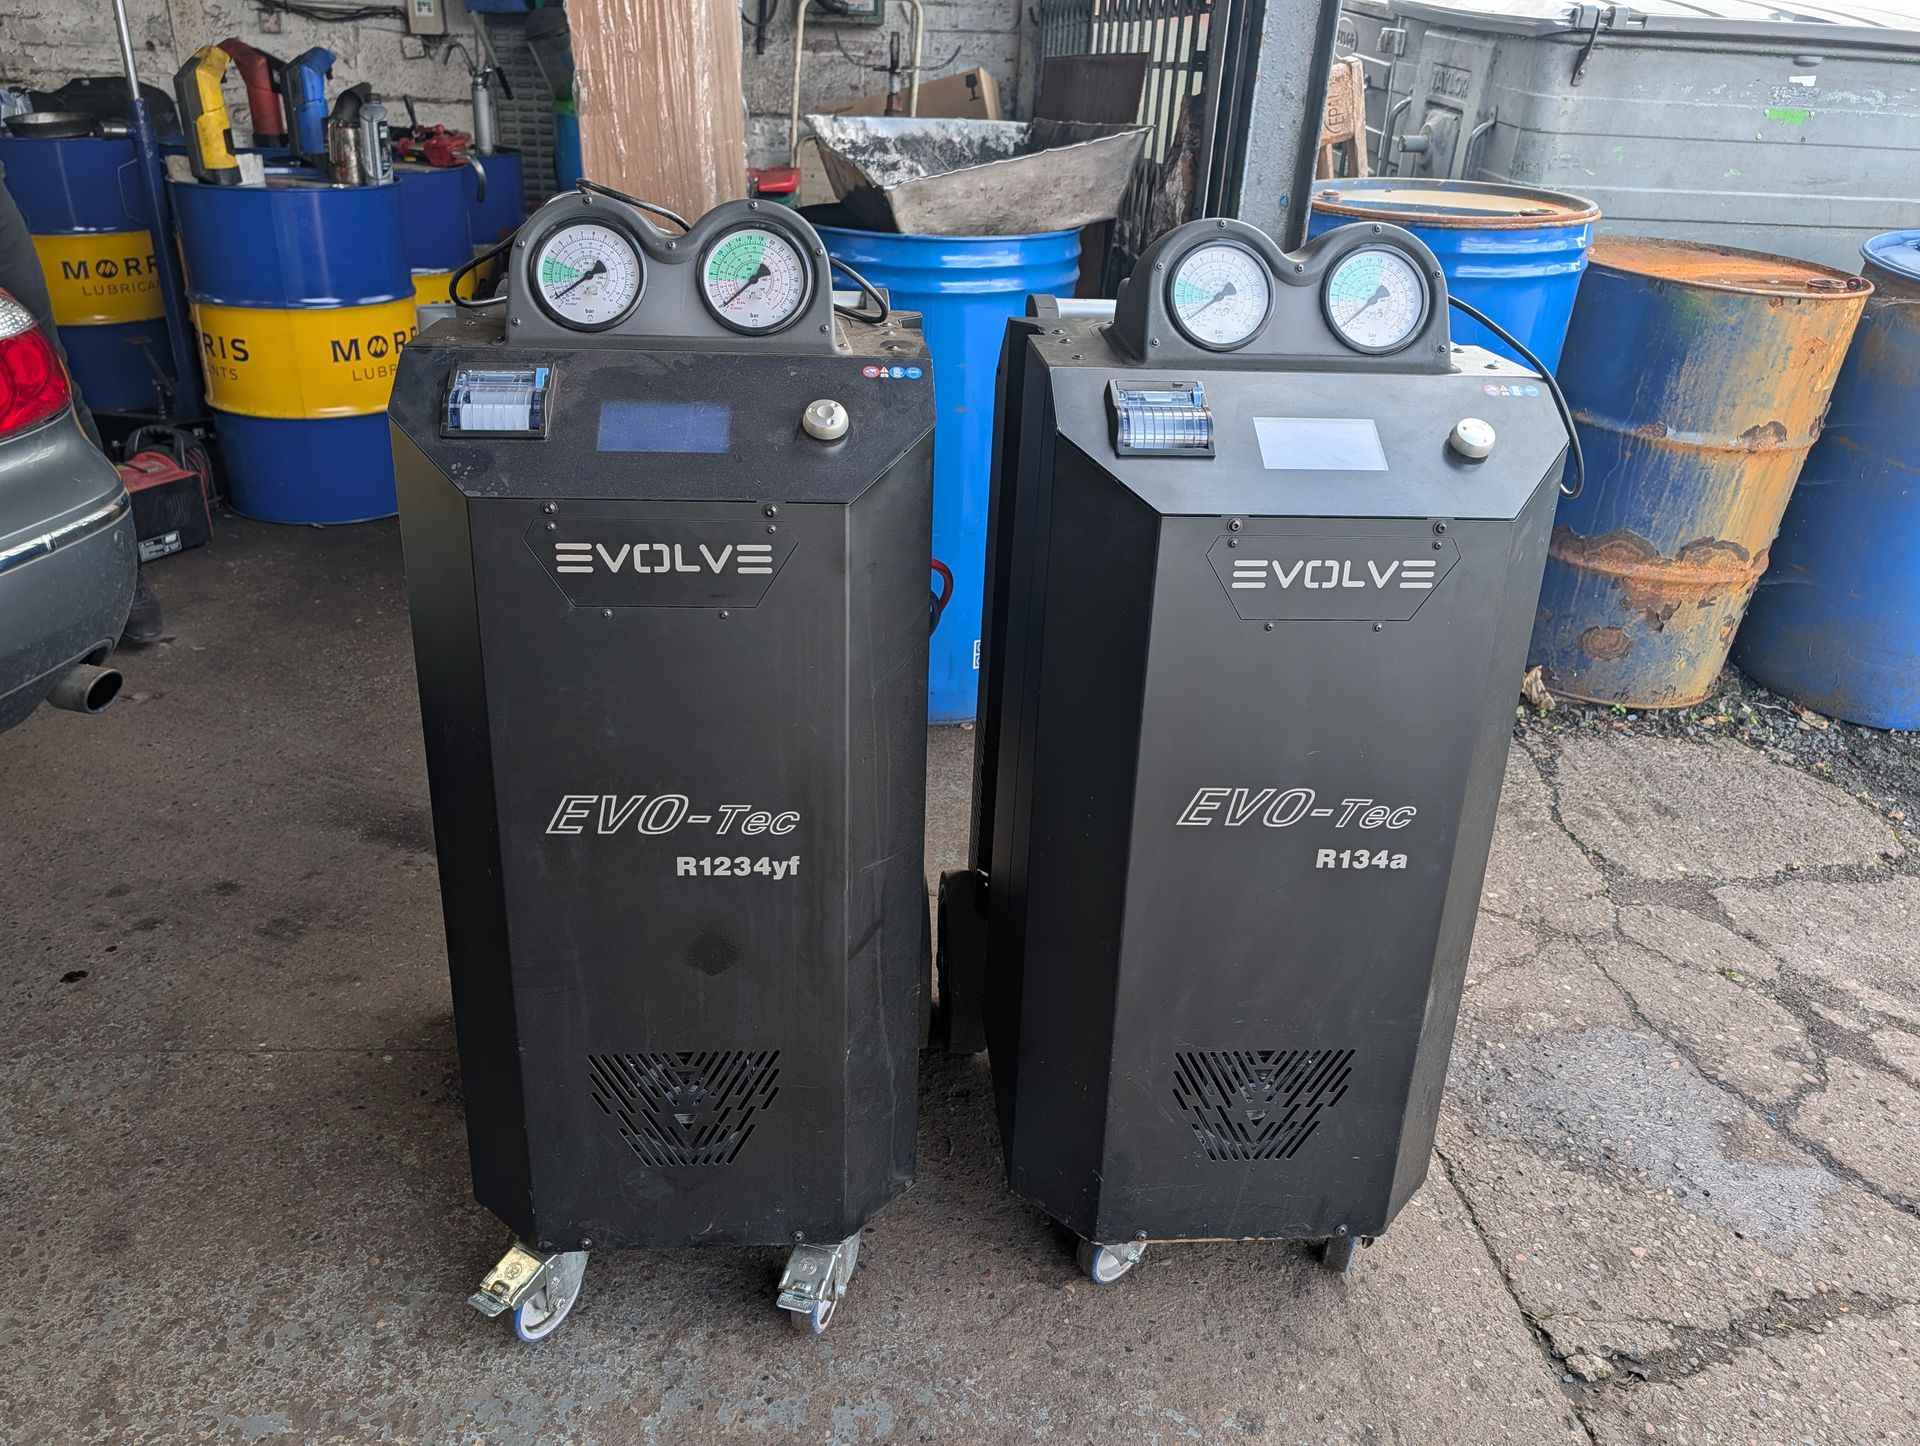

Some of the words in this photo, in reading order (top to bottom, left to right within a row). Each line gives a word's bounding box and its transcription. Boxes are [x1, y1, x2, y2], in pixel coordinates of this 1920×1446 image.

[555, 543, 773, 574] EVOLVE
[1231, 559, 1437, 589] EVOLVE
[545, 794, 800, 835] EVO-Tec
[1175, 788, 1417, 829] EVO-Tec
[676, 856, 800, 880] R1234yf
[1315, 849, 1408, 870] R134a
